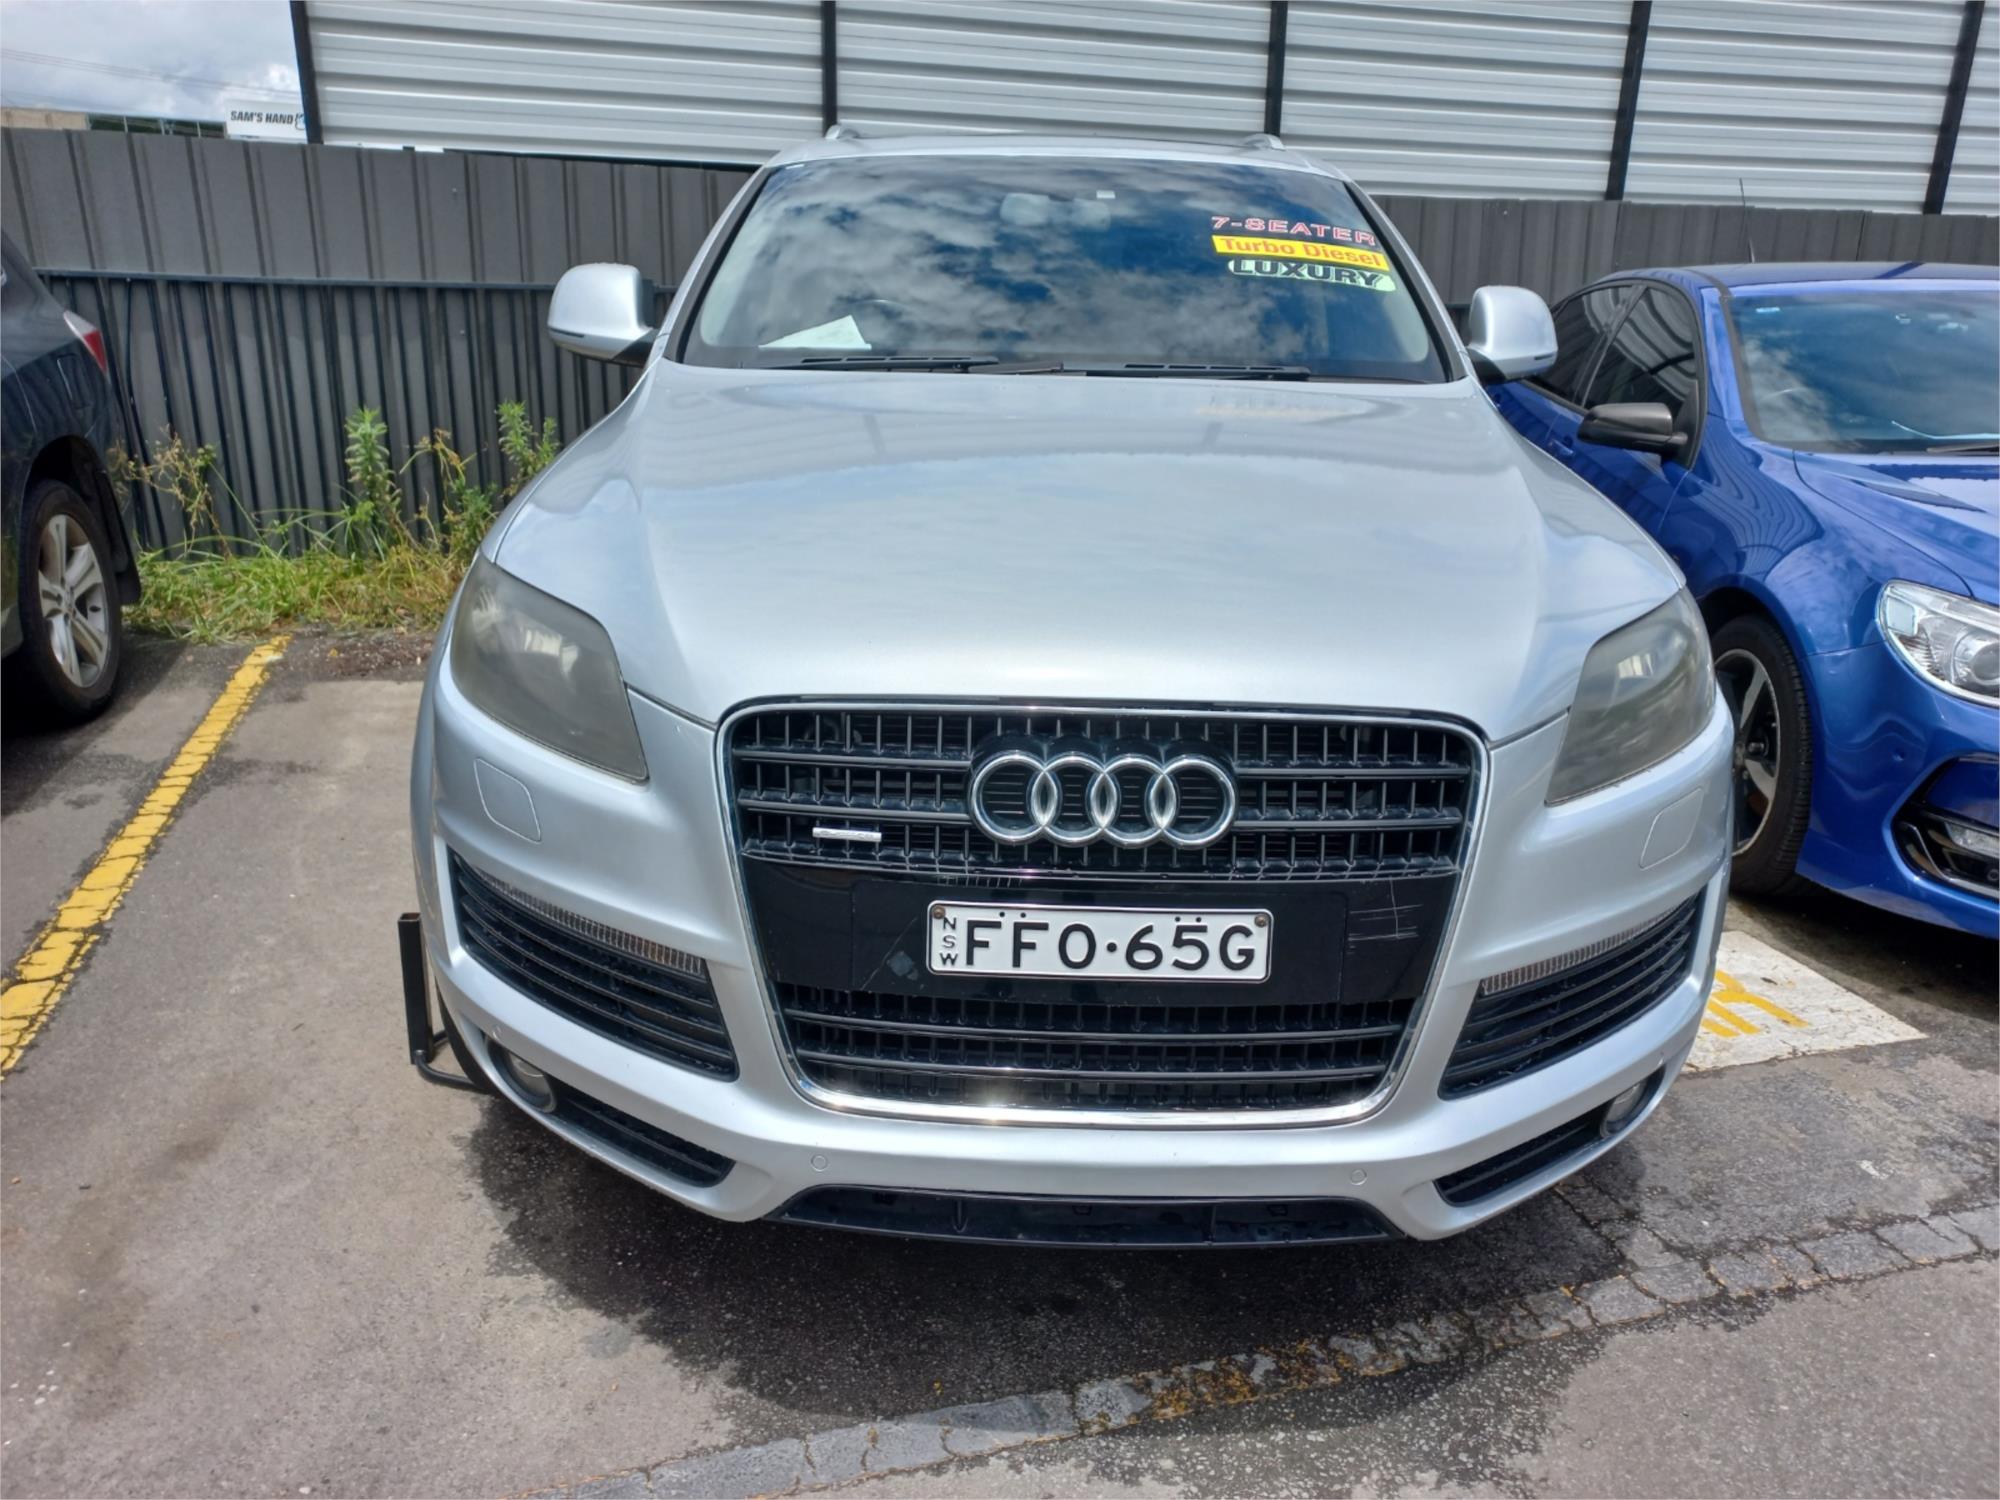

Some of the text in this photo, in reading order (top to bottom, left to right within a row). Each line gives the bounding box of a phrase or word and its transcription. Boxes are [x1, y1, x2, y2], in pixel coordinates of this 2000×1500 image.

[230, 110, 294, 125] SAM'S HAND
[1211, 216, 1376, 246] 7-SEATER
[1220, 237, 1381, 267] Turbo Diesel
[1233, 259, 1380, 286] LUXURY
[941, 916, 958, 966] NSW
